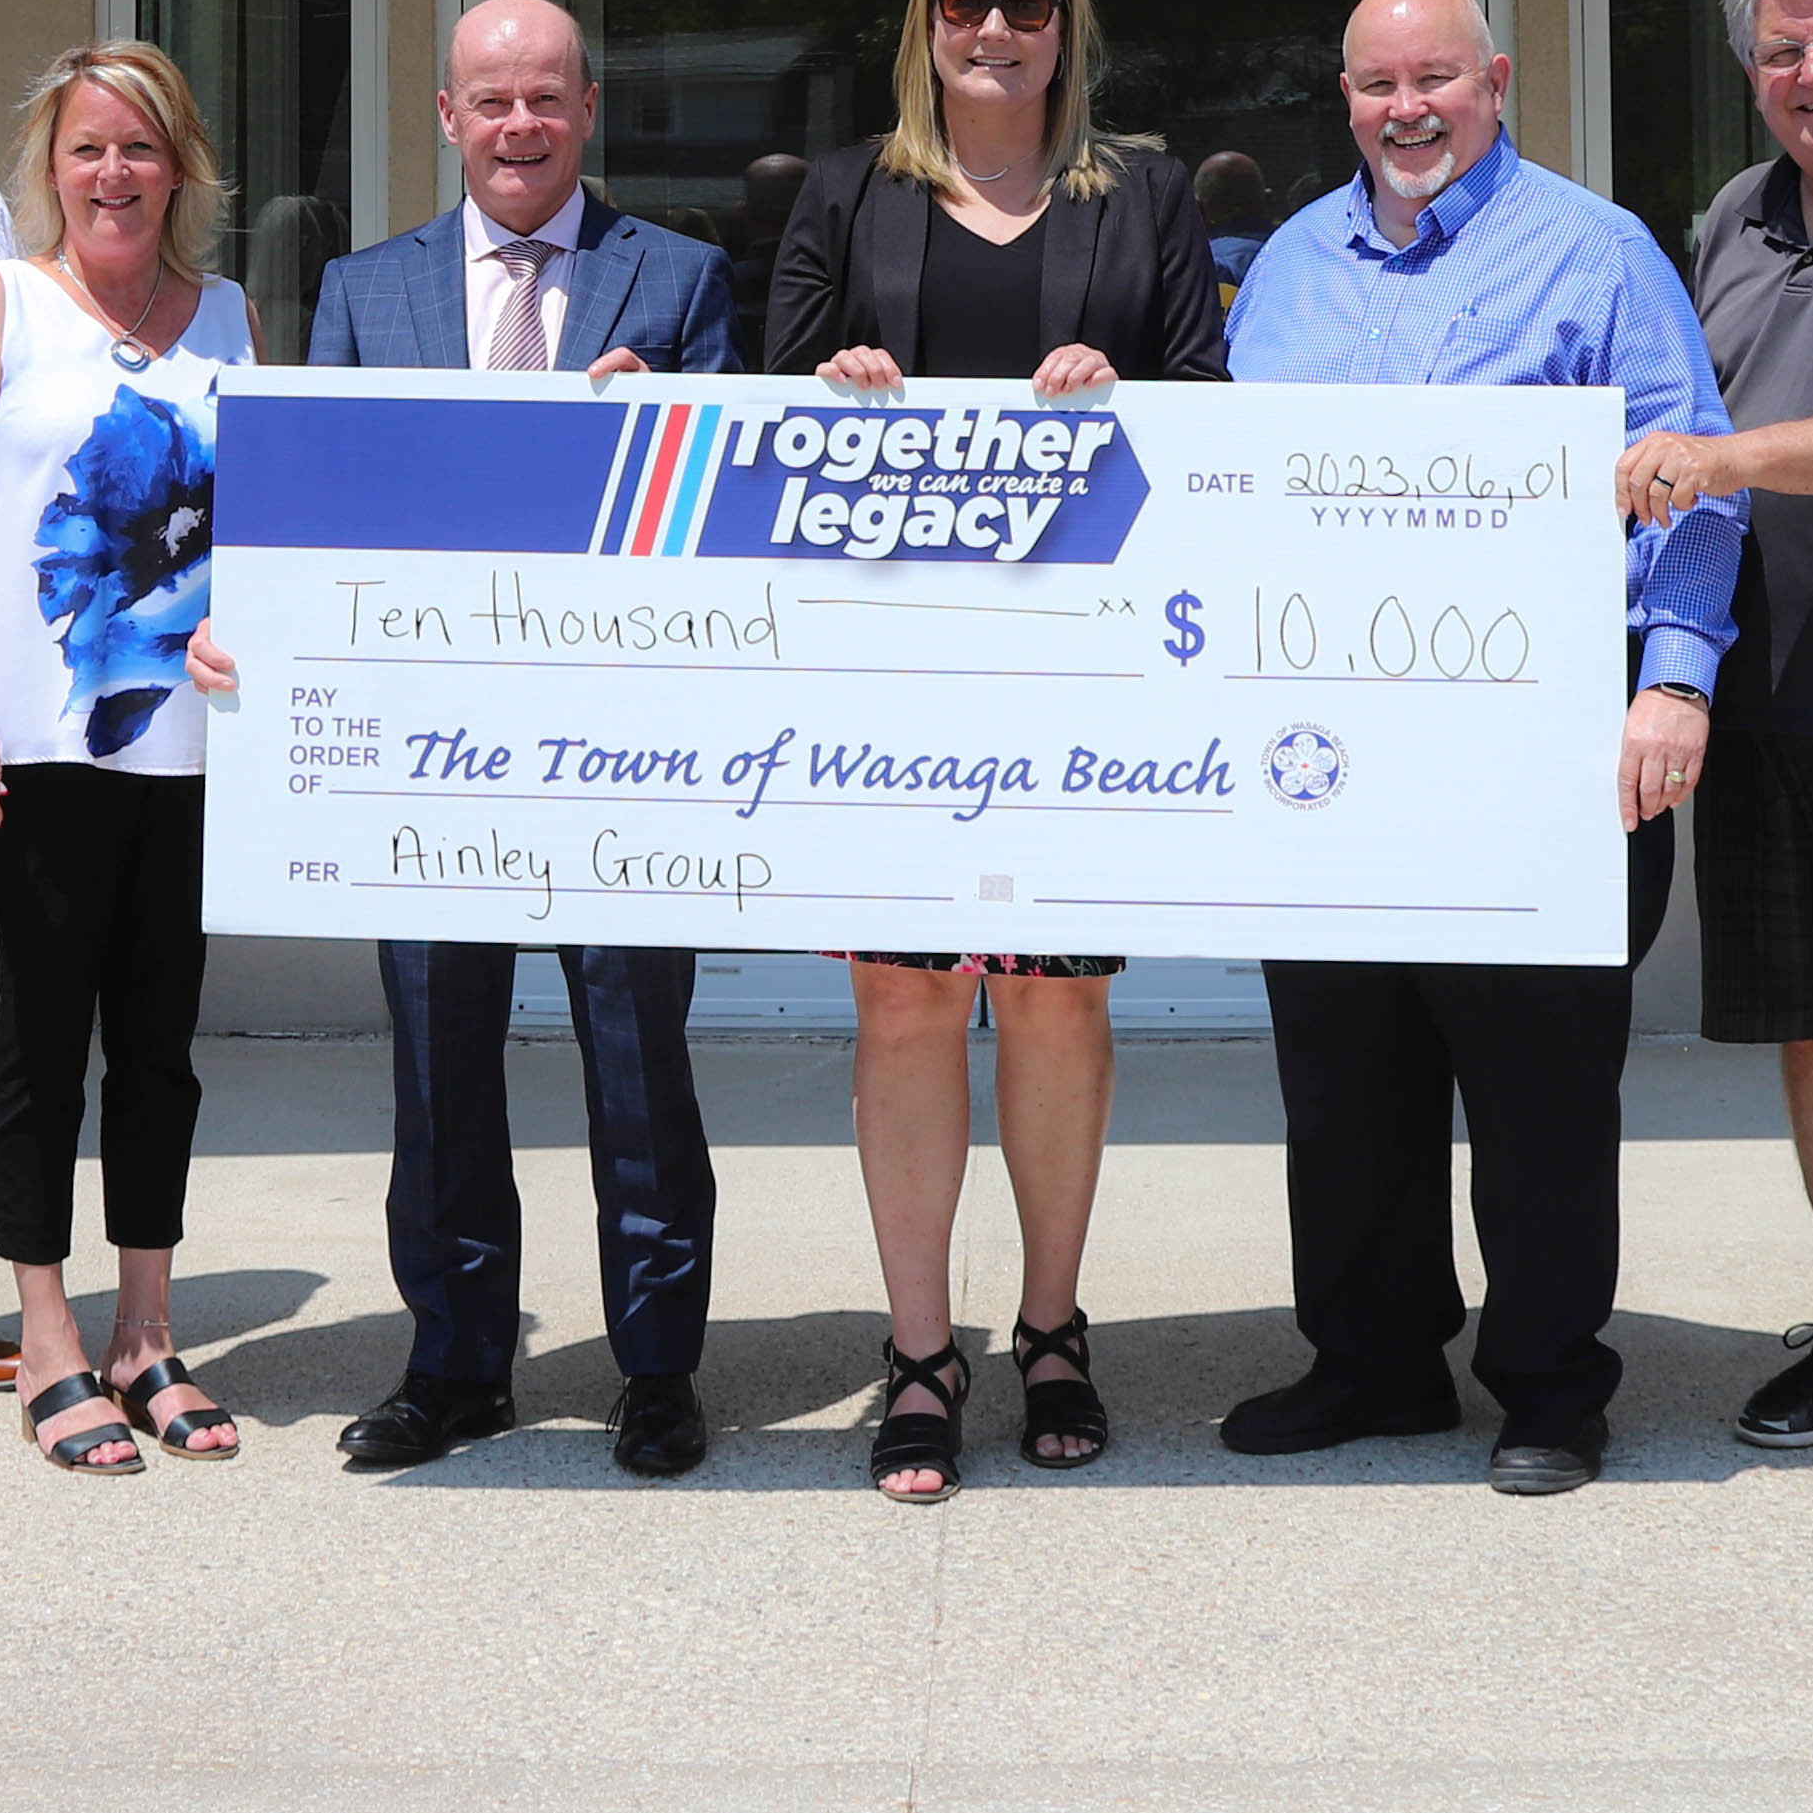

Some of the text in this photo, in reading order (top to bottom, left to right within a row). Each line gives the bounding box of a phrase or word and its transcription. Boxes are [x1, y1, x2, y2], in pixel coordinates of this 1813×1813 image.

[729, 404, 1115, 482] Together
[869, 472, 1089, 495] we can create a
[1188, 473, 1255, 493] DATE
[770, 476, 1063, 562] legacy
[336, 570, 780, 660] Ten thousand
[1163, 589, 1206, 667] $
[290, 688, 338, 708] PAY
[290, 716, 382, 738] TO THE
[289, 746, 380, 767] ORDER
[289, 774, 322, 794] OF
[405, 727, 1236, 821] The Town of Wasaga Beach
[288, 861, 340, 882] PER
[392, 825, 772, 920] Ainley Group
